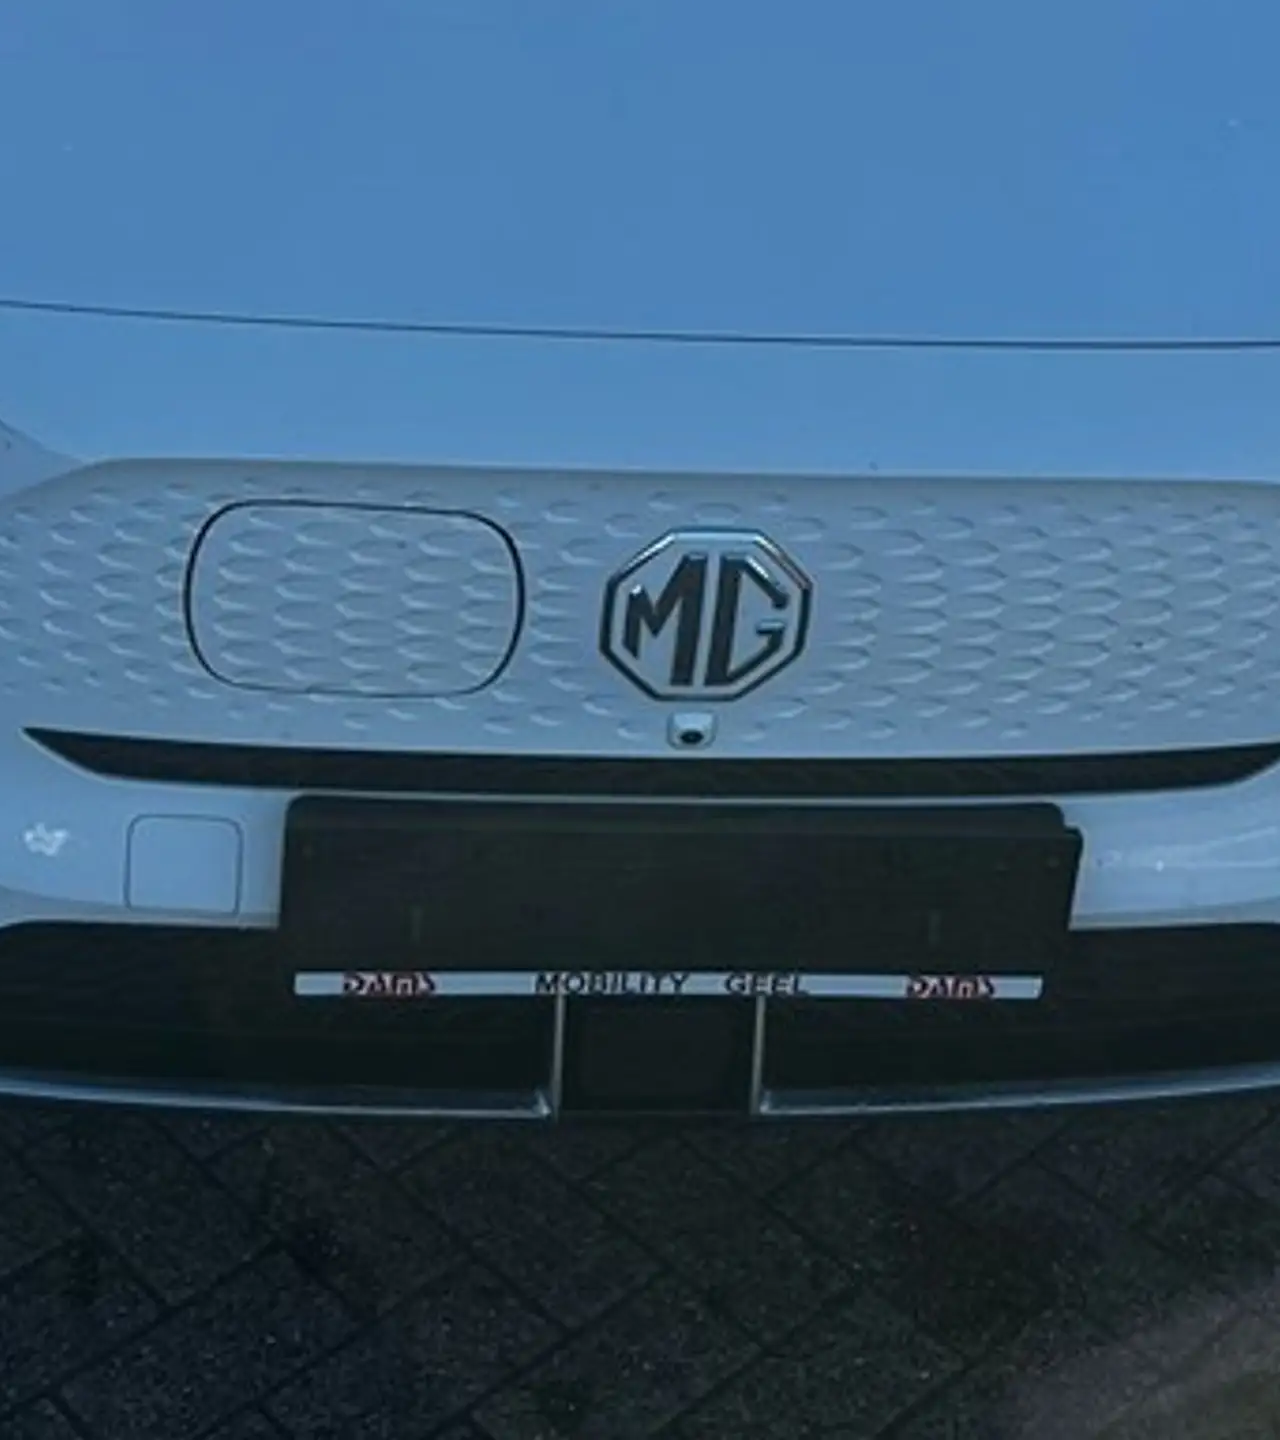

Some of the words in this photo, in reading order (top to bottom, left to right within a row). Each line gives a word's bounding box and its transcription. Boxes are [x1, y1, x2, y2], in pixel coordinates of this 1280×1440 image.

[622, 550, 789, 688] MG
[533, 971, 688, 997] MOBILITY
[724, 971, 810, 997] GEEL
